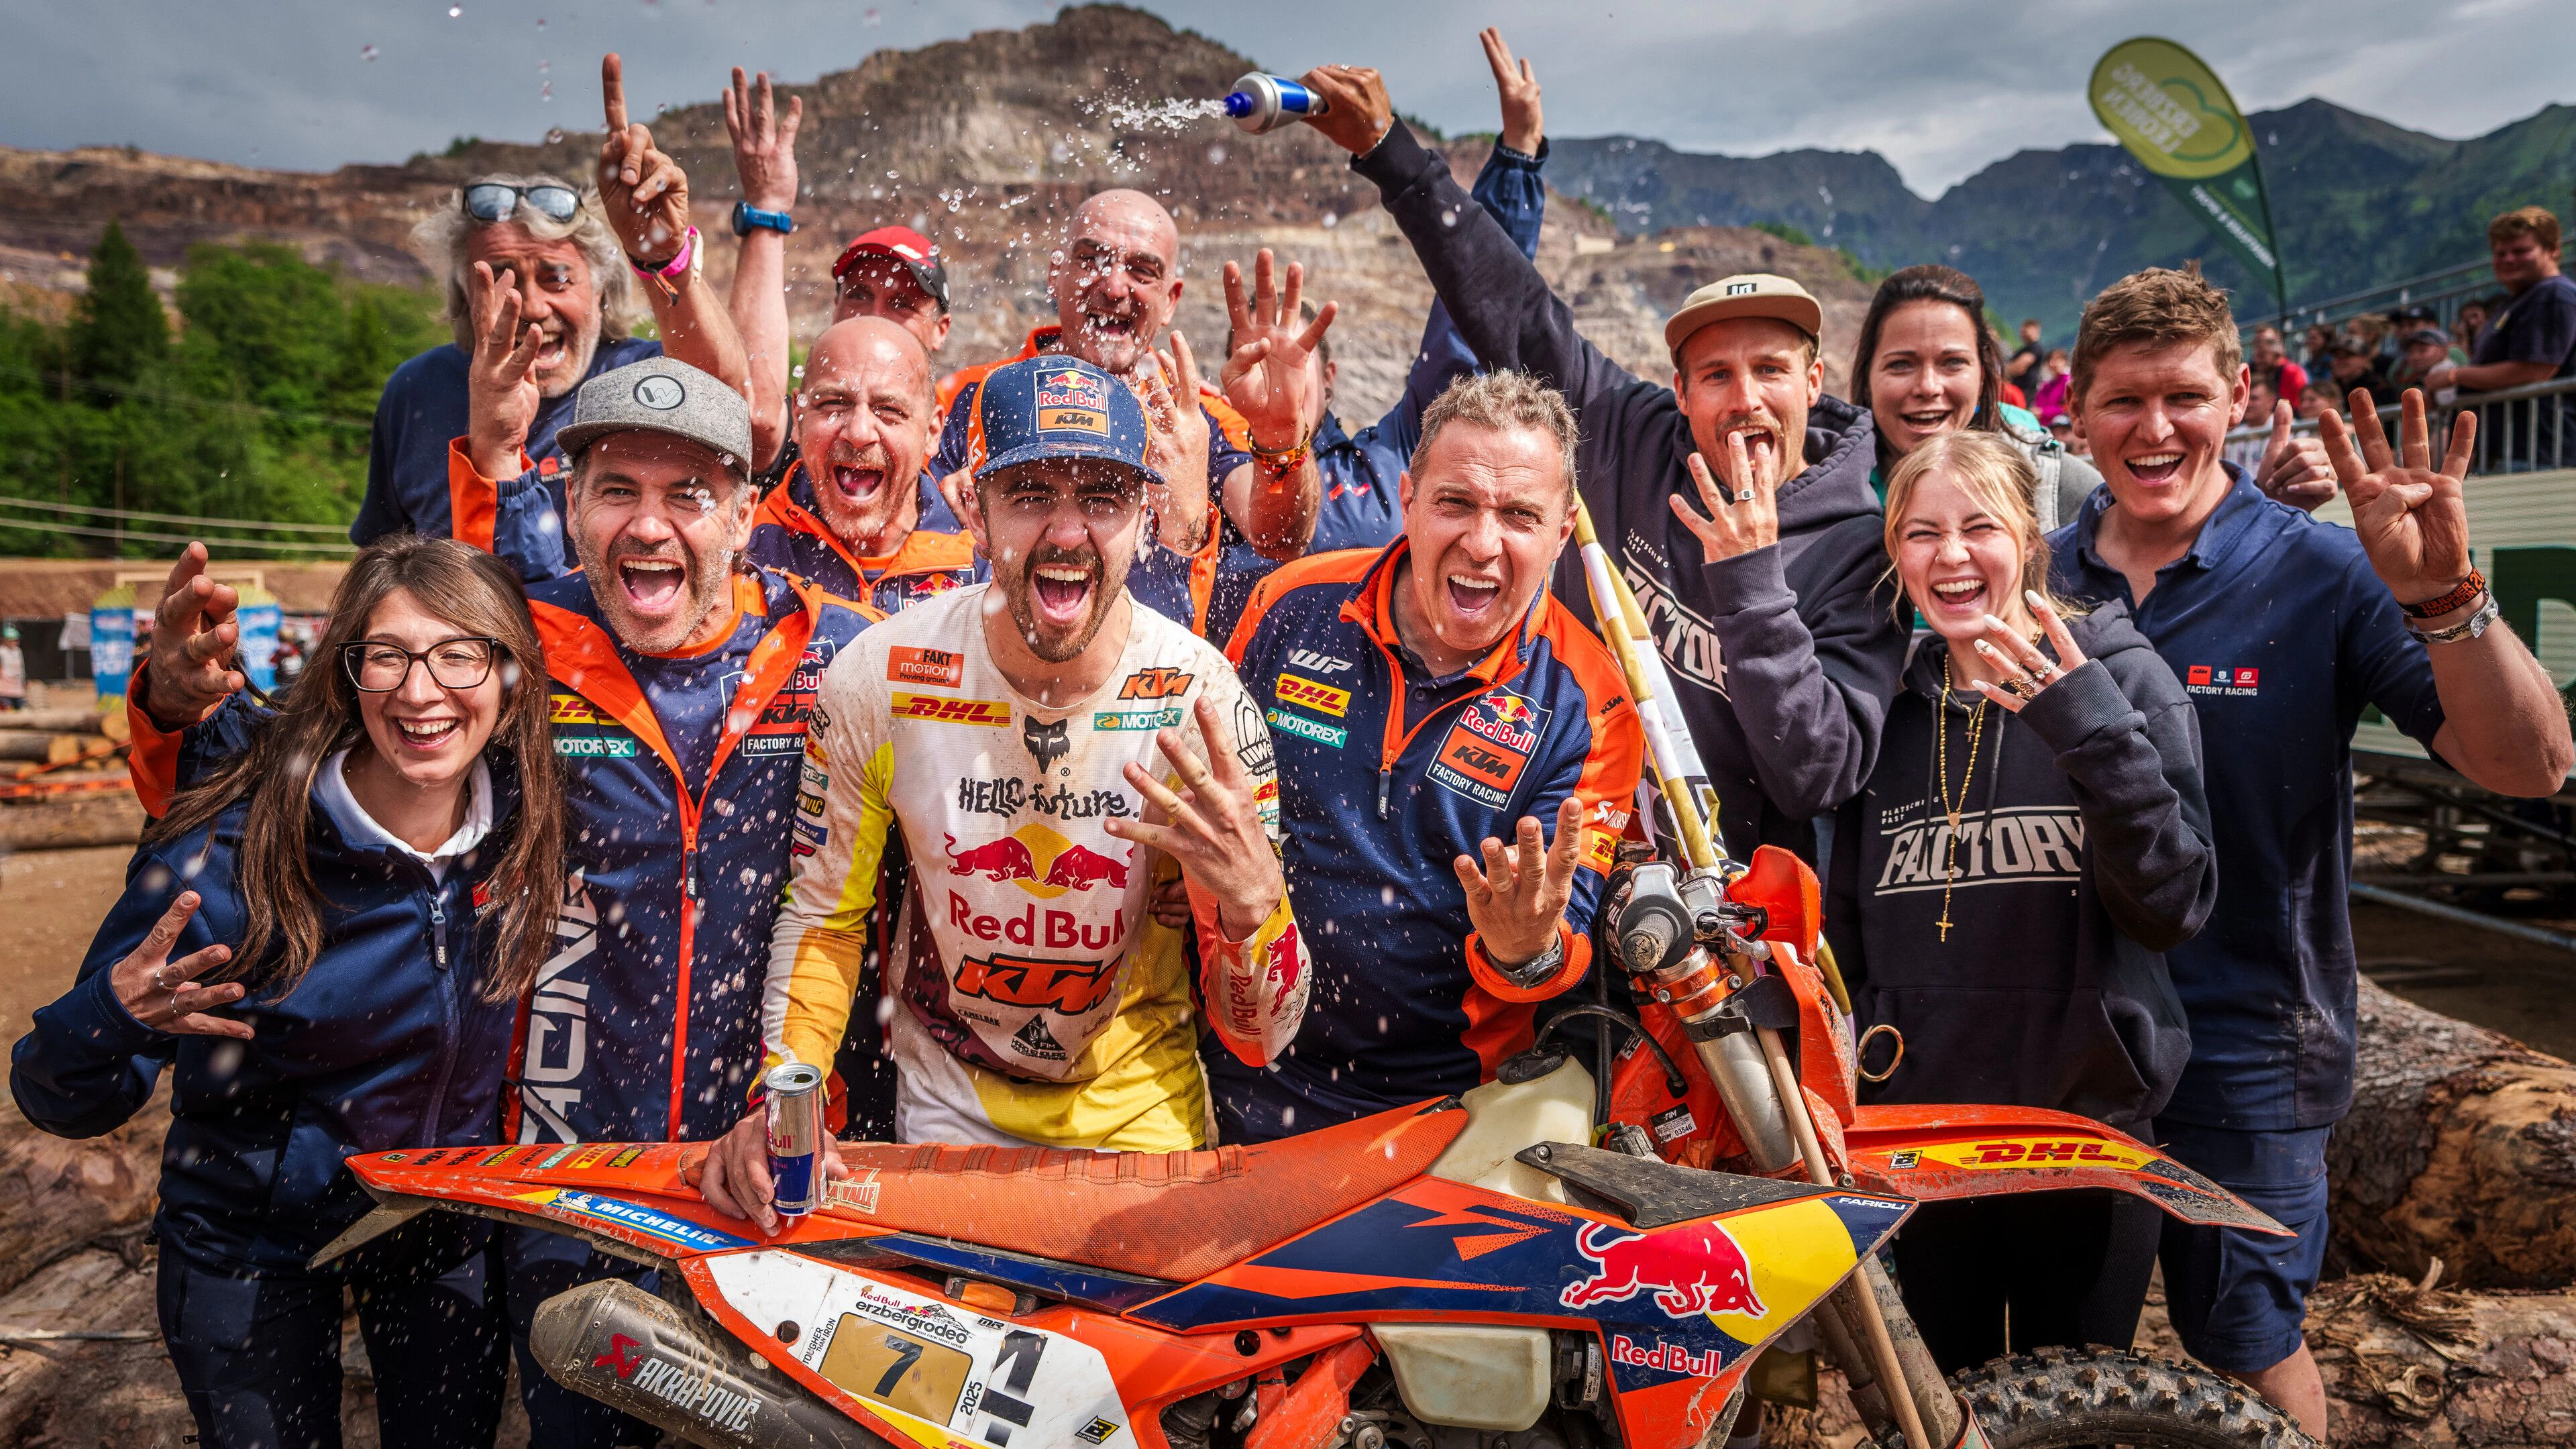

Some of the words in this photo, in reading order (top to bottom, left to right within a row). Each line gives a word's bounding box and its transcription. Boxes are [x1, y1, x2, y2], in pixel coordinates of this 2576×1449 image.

[1039, 389, 1073, 407] Red
[1074, 390, 1106, 411] Bull
[1055, 413, 1093, 426] KTM
[2418, 581, 2471, 611] TOUGHER
[2423, 603, 2454, 617] THAN
[2453, 588, 2478, 609] IRON
[922, 649, 952, 666] FAKT
[900, 672, 925, 684] Proving
[926, 676, 950, 684] ground
[2186, 685, 2223, 695] FACTORY
[2224, 688, 2257, 696] RACING
[907, 697, 994, 722] DHL
[1277, 679, 1342, 711] DHL
[1600, 695, 1625, 714] KTM
[1122, 710, 1176, 729] MOTOEX
[1277, 712, 1342, 745] MOTOREX
[1460, 705, 1501, 739] Red
[1496, 721, 1537, 753] Bull
[747, 737, 792, 751] FACTORY
[1452, 745, 1511, 780] KTM
[1432, 764, 1472, 794] FACTORY
[1472, 782, 1507, 804] RACING
[1881, 814, 1905, 825] FAST
[948, 888, 1036, 947] Red
[953, 948, 1126, 1016] KTM
[1230, 968, 1257, 1007] Red
[517, 865, 598, 1145] ACING
[957, 1008, 1002, 1028] CAMELBAK
[1232, 1007, 1262, 1036] Bull
[1040, 1041, 1056, 1049] FIM
[1674, 1124, 1693, 1136] 03546
[1974, 1142, 2119, 1163] DHL
[594, 1202, 727, 1245] MICHELIN
[860, 1291, 879, 1304] Red
[880, 1294, 900, 1308] Bull
[816, 1338, 826, 1353] THAN
[822, 1318, 837, 1339] IRON
[855, 1300, 967, 1344] erzbergrodeo
[802, 1327, 824, 1364] TOUGHER
[1611, 1334, 1668, 1371] Red
[1667, 1344, 1722, 1377] Bull
[873, 1334, 924, 1399] 7
[632, 1356, 763, 1432] AKRAPOVIČ
[959, 1380, 983, 1417] 2025
